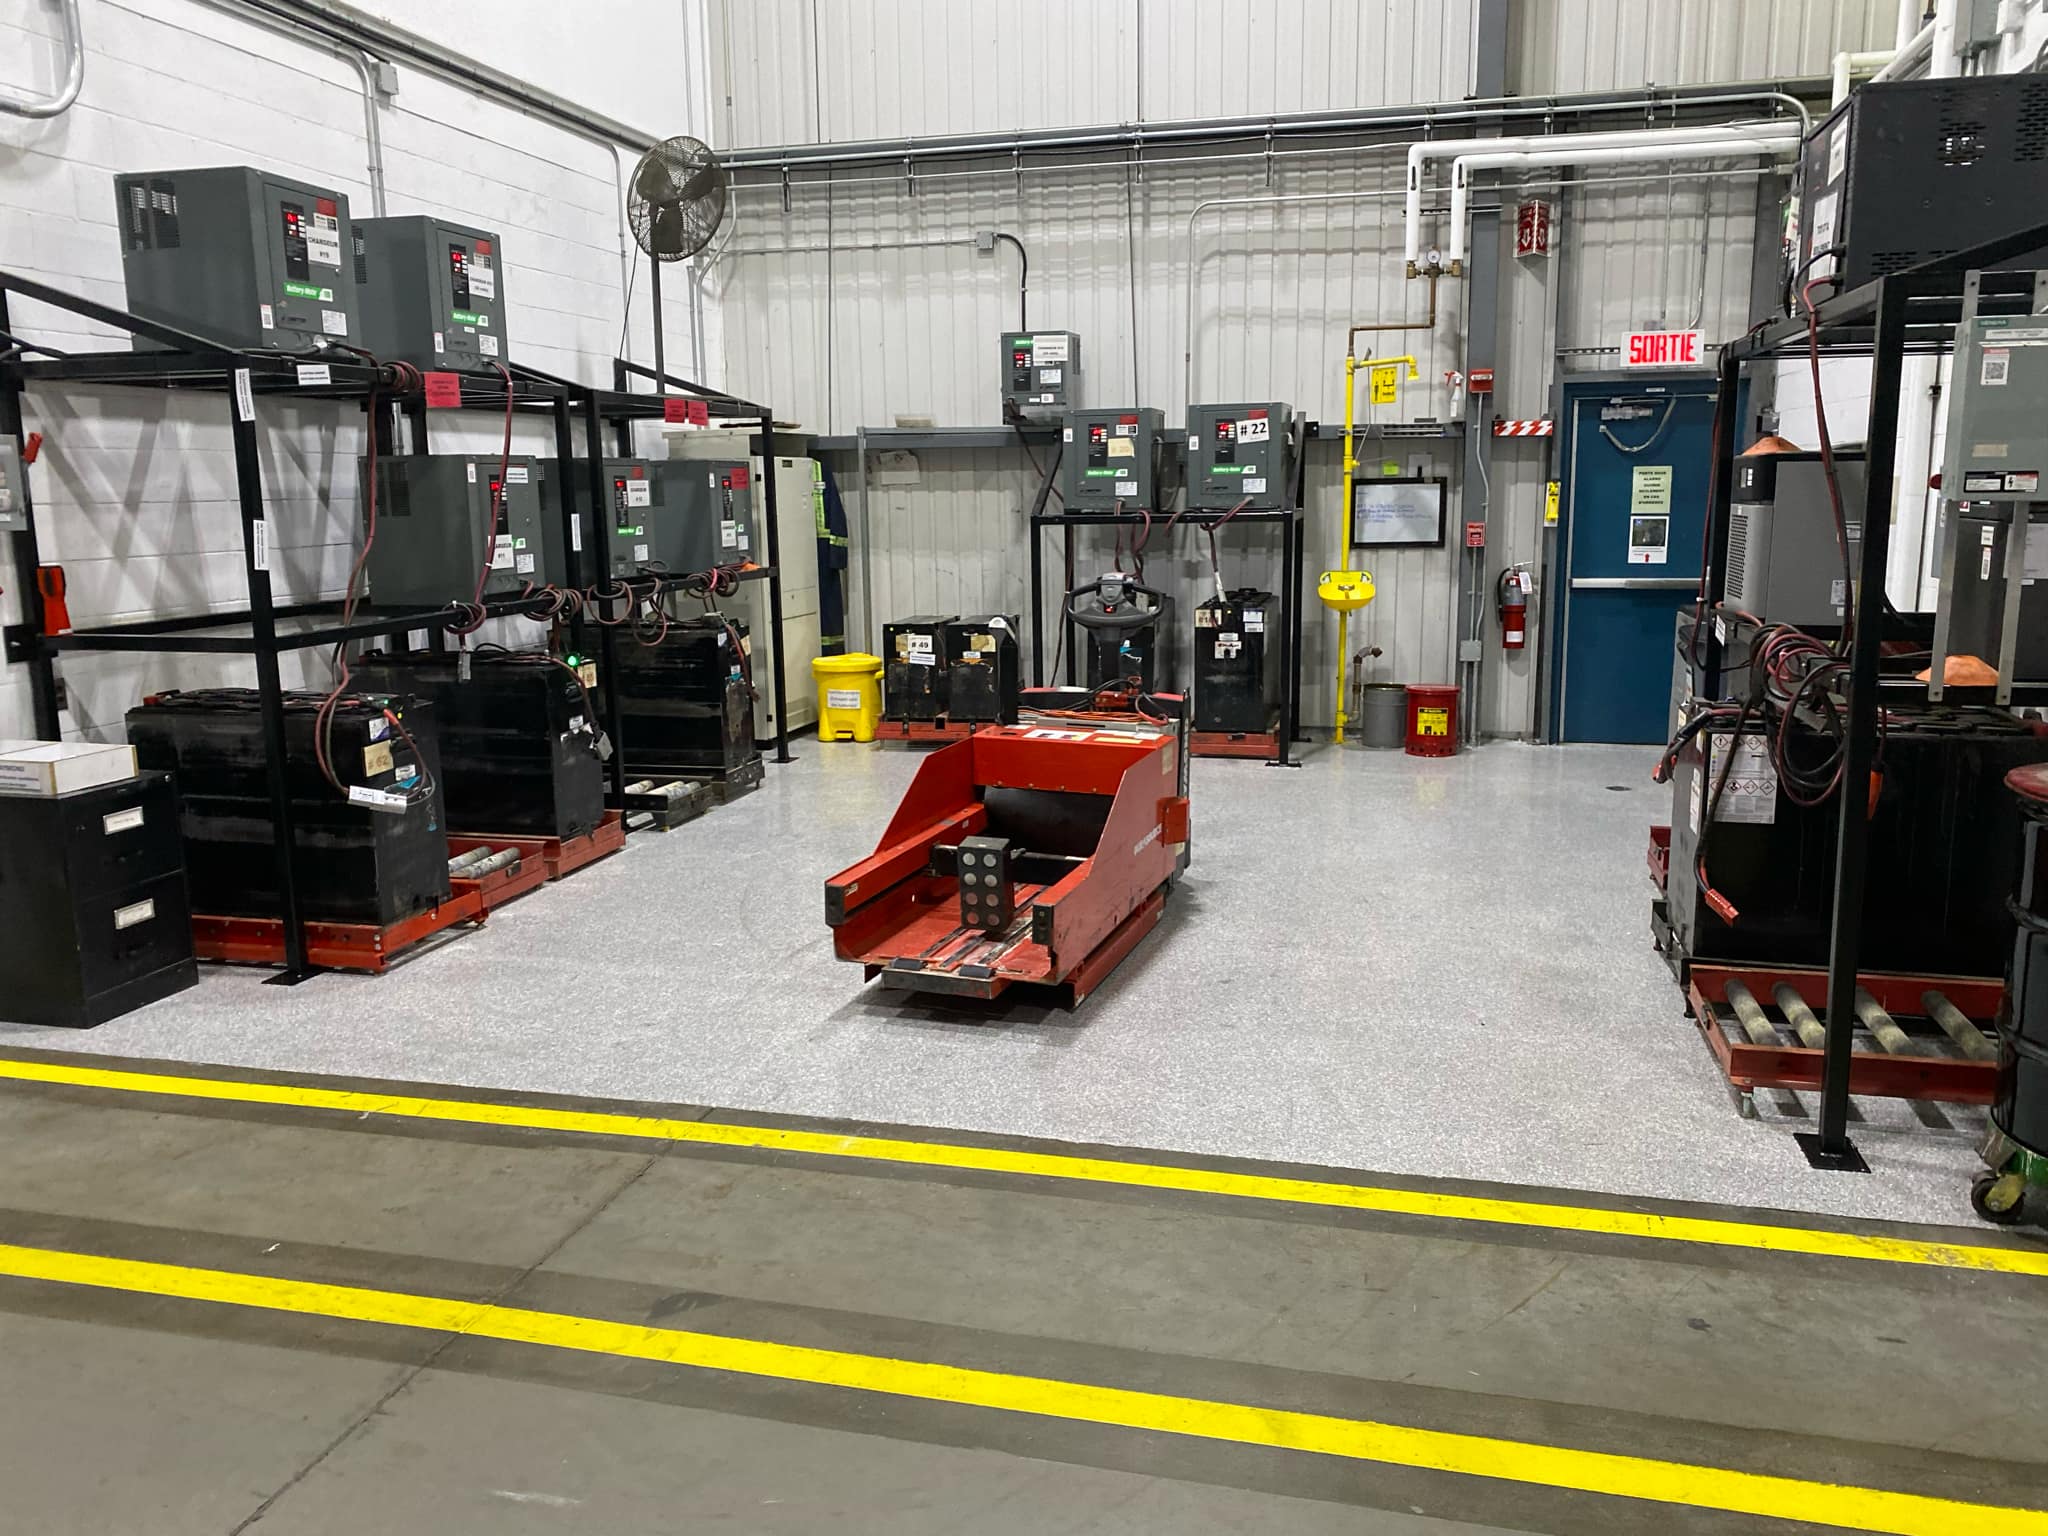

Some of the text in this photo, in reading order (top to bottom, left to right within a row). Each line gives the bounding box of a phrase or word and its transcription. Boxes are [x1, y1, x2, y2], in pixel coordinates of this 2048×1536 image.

[1629, 333, 1697, 364] SORTIE
[1240, 422, 1267, 437] # 22
